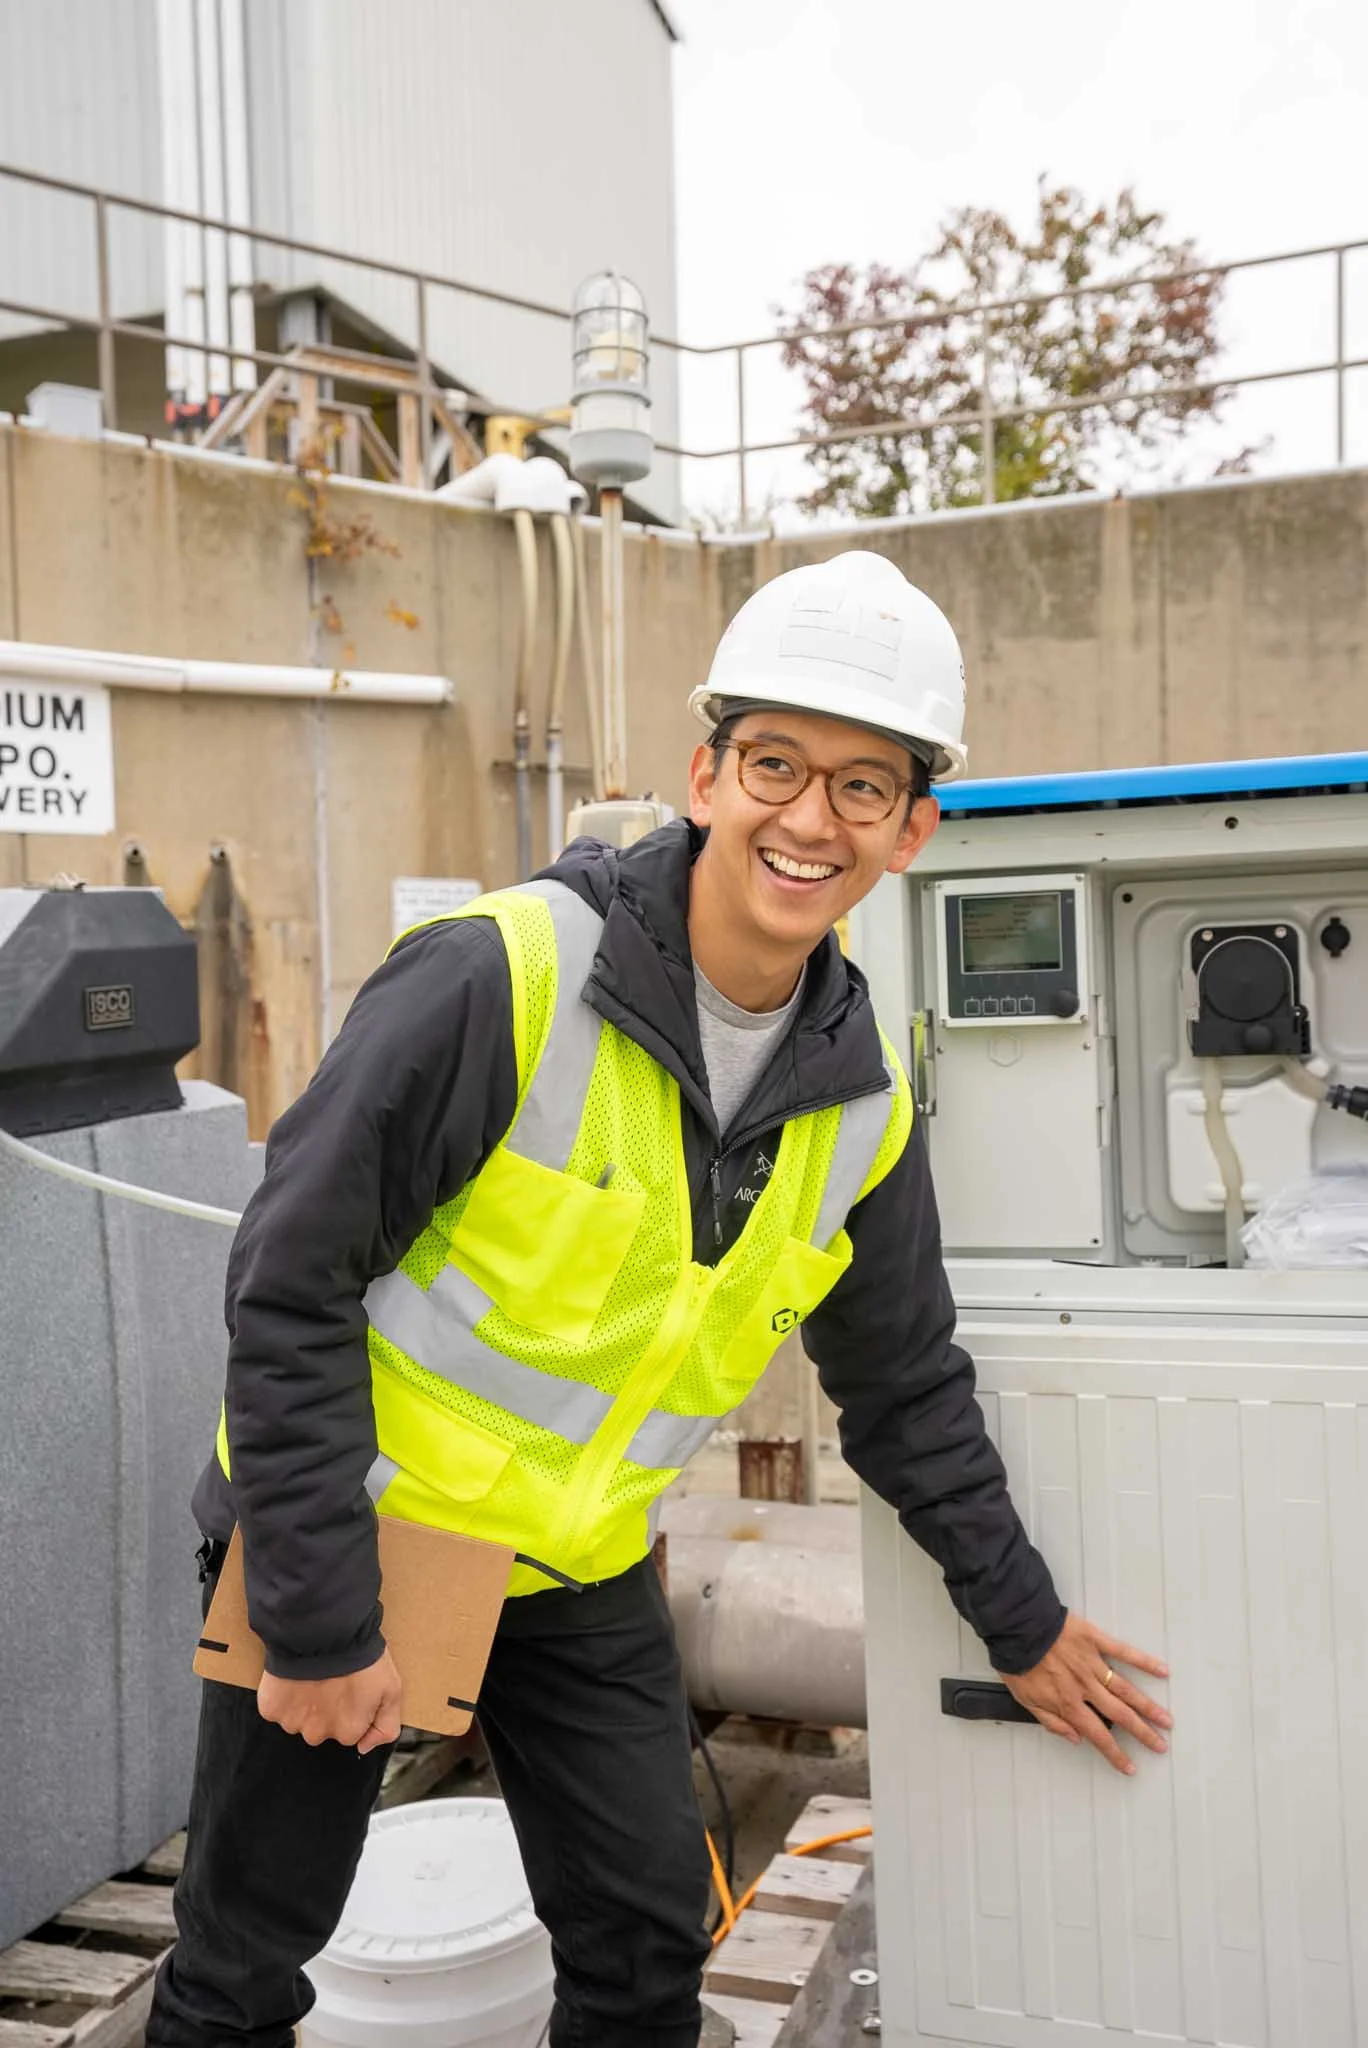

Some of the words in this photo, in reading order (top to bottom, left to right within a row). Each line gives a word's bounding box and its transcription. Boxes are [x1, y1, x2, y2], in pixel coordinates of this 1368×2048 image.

[5, 691, 84, 732] IUM
[0, 744, 71, 779] PO.
[90, 989, 130, 1013] ISCO
